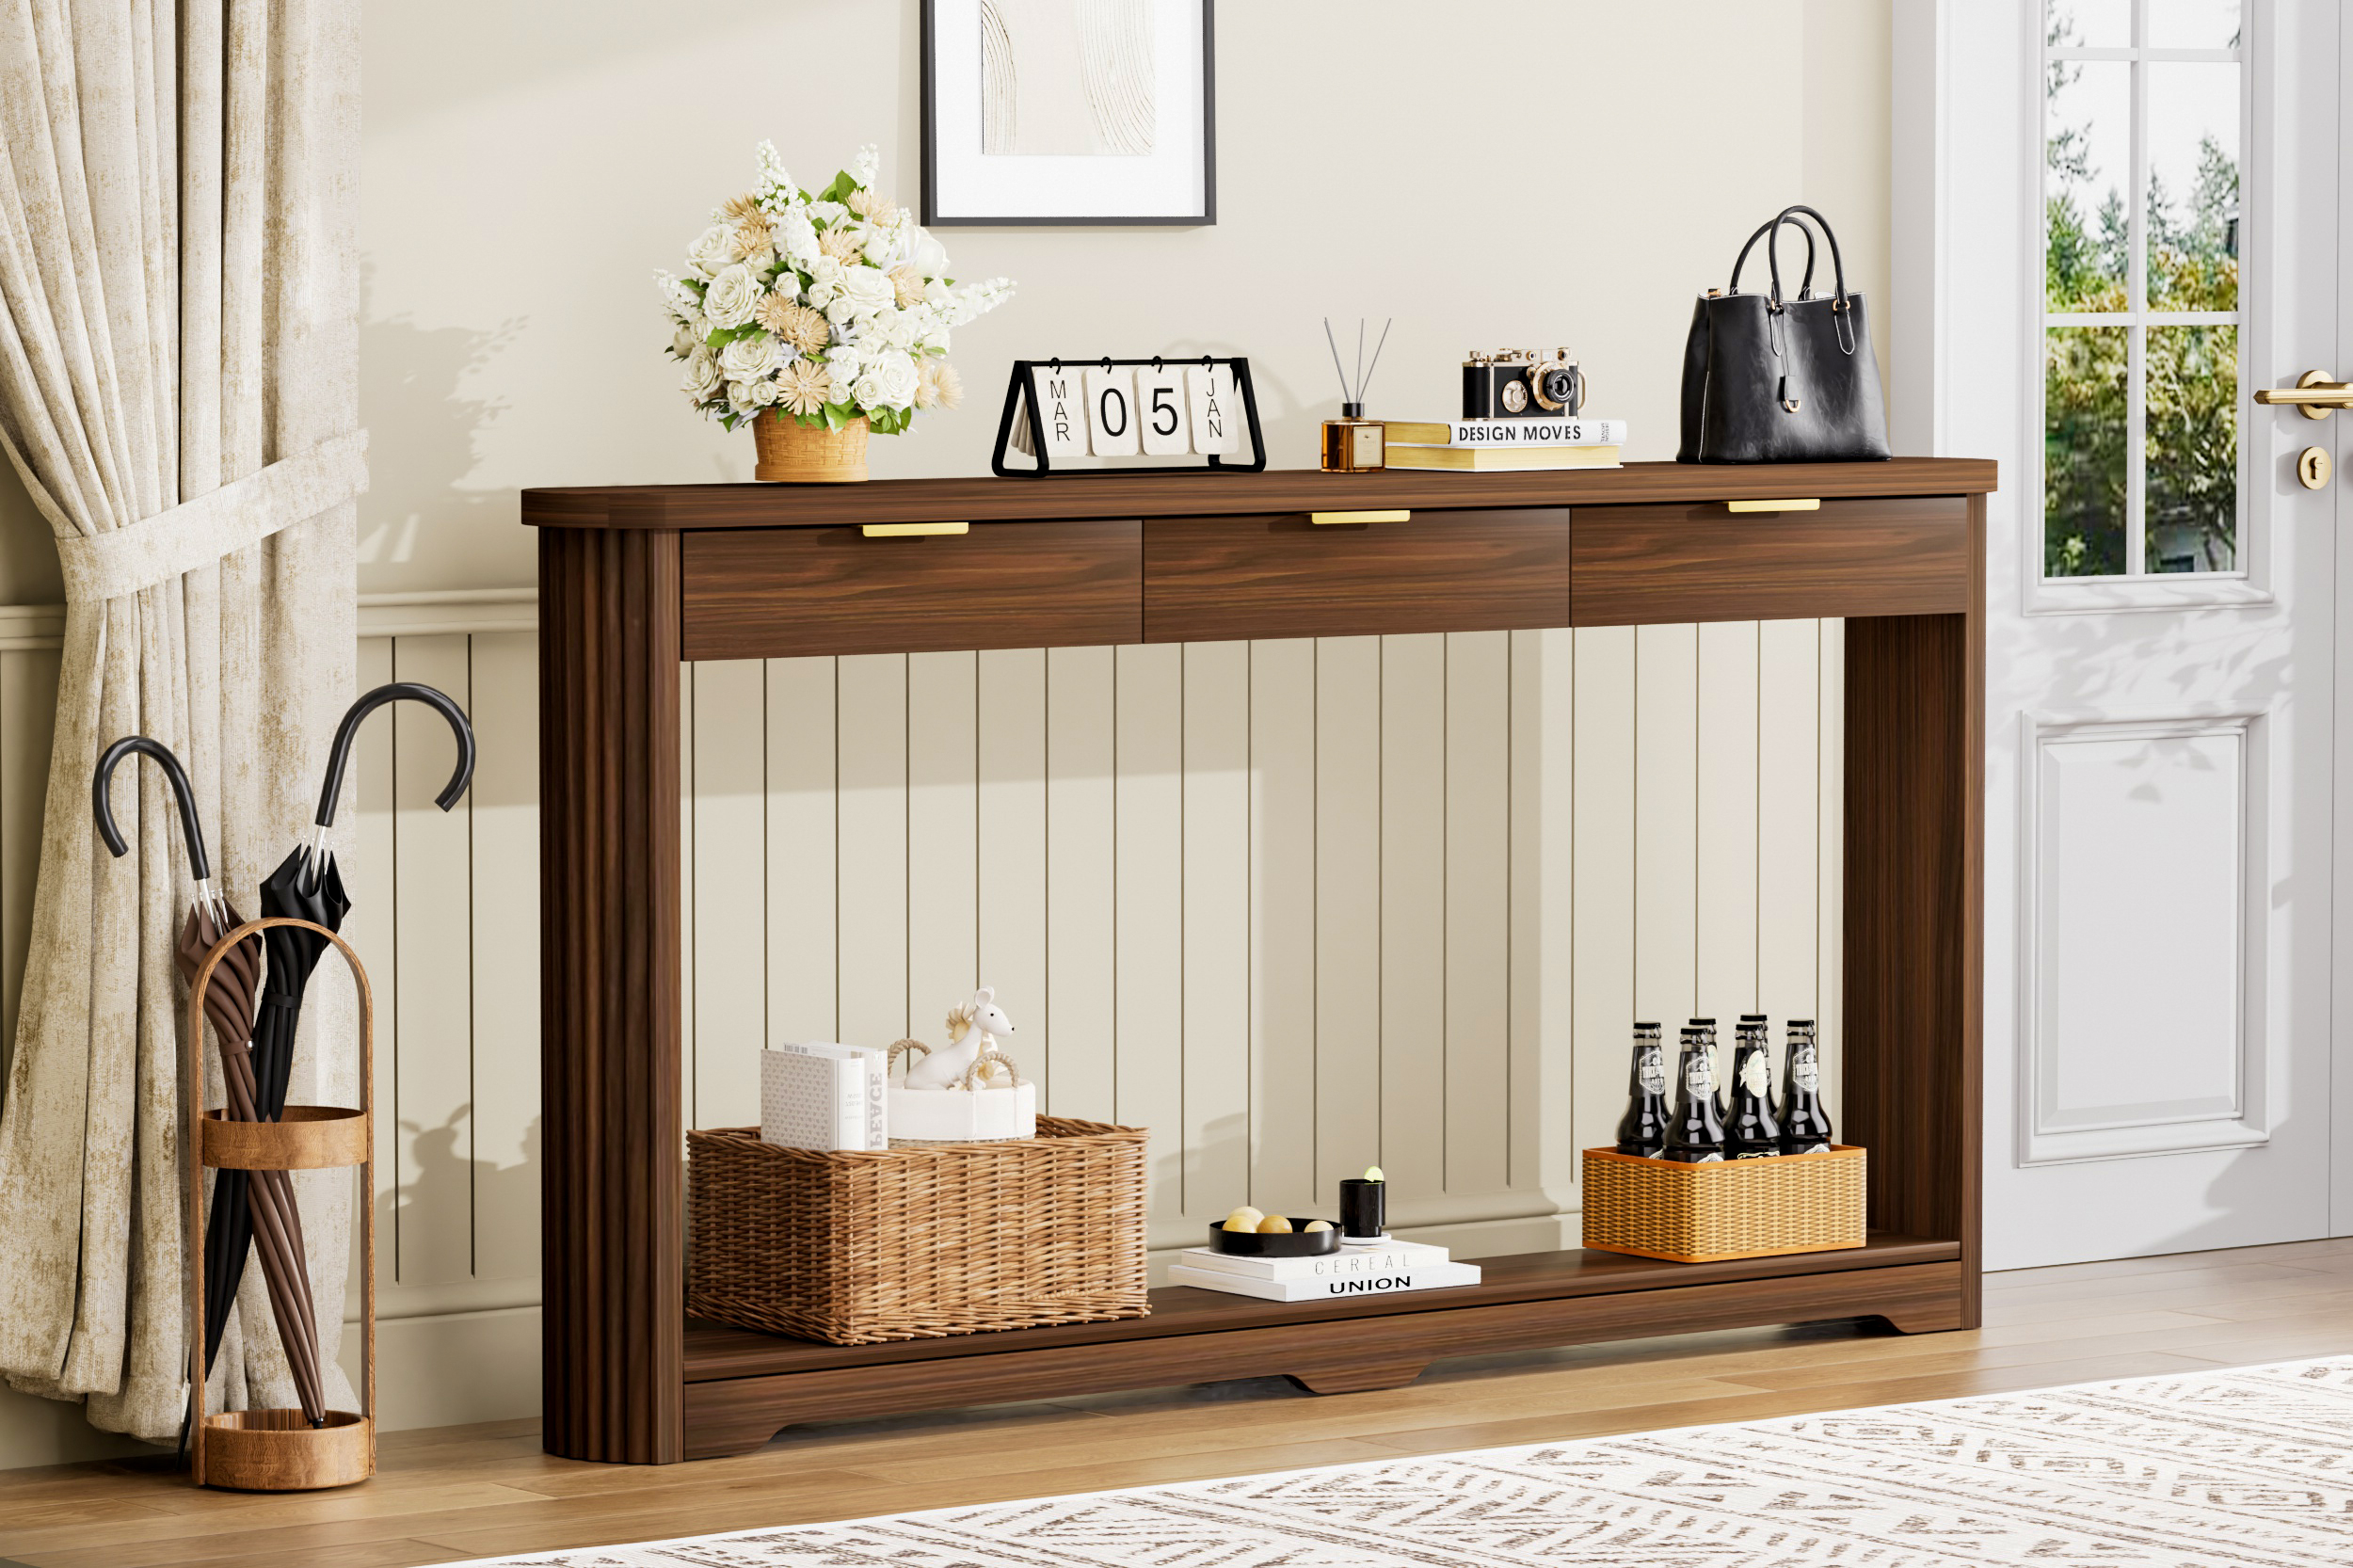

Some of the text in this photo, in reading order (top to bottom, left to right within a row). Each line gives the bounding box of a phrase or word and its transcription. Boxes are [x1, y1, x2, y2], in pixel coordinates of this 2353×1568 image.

[1049, 379, 1071, 442] MAR
[1206, 377, 1223, 439] JAN
[1459, 424, 1581, 441] DESIGN MOVES
[1315, 1254, 1411, 1275] CEREAL
[1330, 1275, 1411, 1294] UNION
